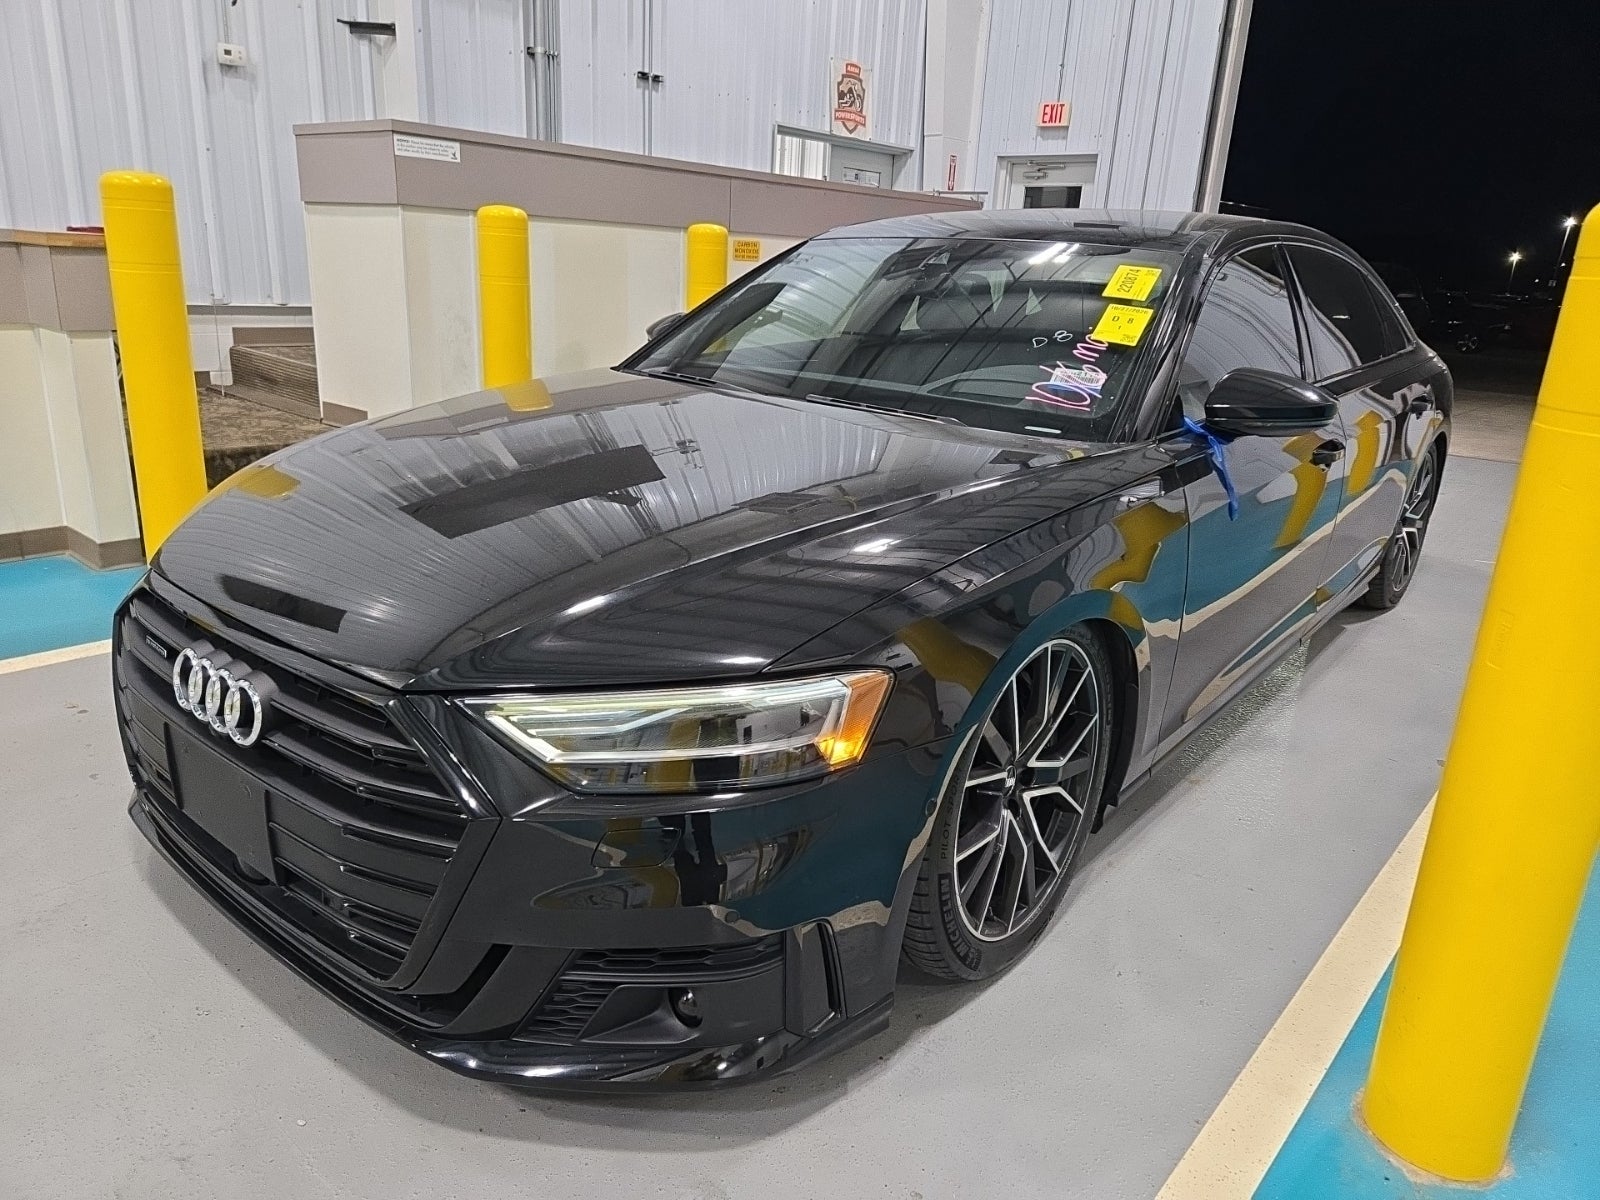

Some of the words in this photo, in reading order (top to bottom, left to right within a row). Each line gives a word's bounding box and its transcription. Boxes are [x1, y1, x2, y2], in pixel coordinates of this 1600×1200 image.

[1041, 103, 1066, 124] EXIT
[1116, 269, 1142, 293] 220874
[1032, 337, 1048, 348] D
[1052, 330, 1073, 342] 8
[940, 818, 952, 860] PILOT
[940, 878, 970, 958] MICHELIN
